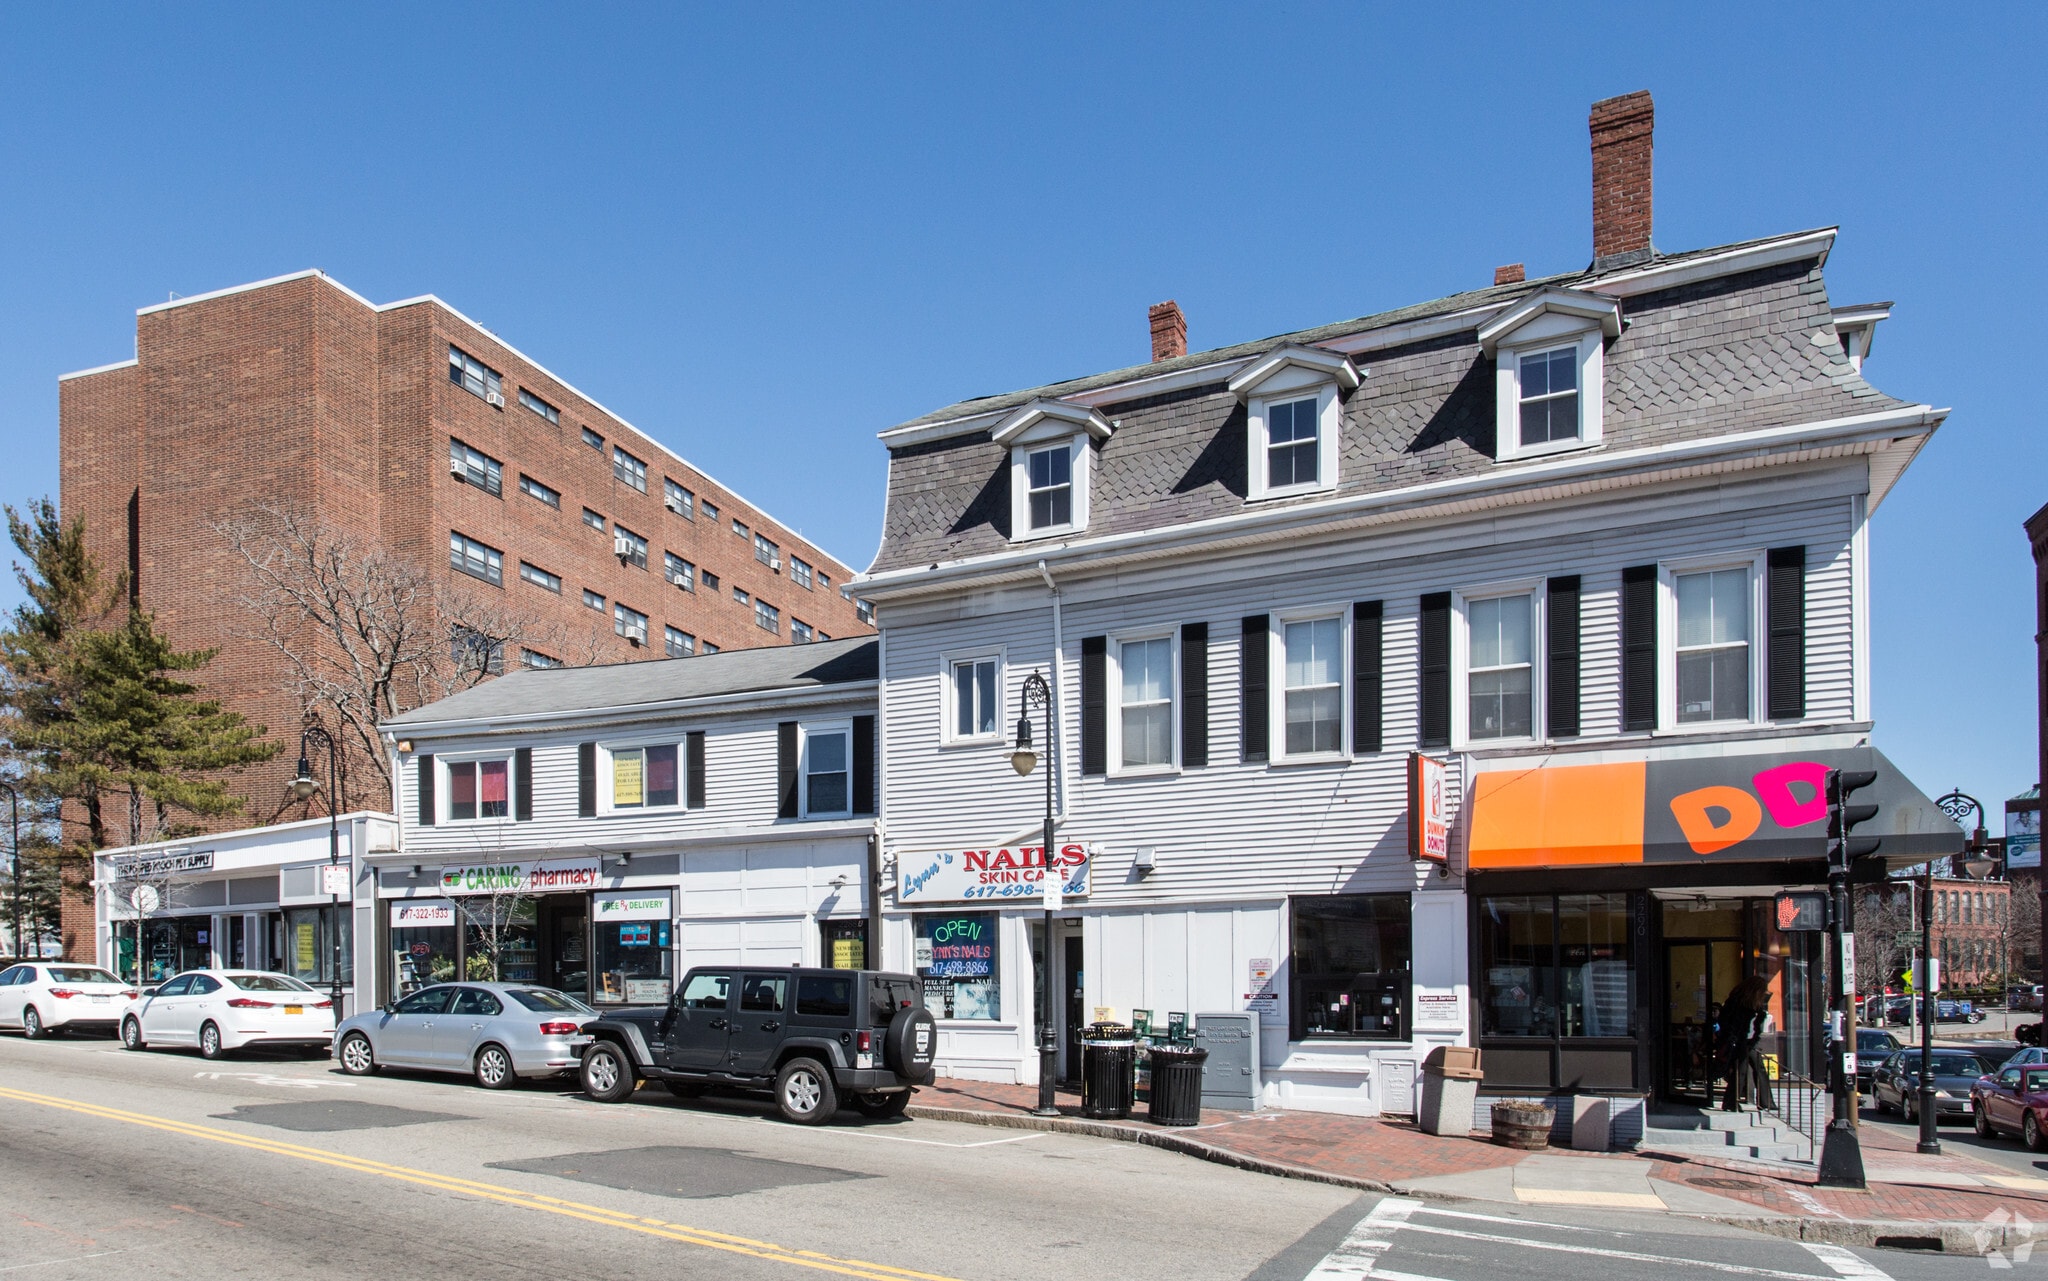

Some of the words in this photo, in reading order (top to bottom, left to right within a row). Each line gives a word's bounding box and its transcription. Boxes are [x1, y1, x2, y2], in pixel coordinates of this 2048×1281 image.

[188, 854, 210, 867] SUPPLY
[963, 844, 1087, 872] NAILS
[530, 866, 597, 889] pharmacy
[979, 870, 1021, 885] SKIN
[1023, 868, 1069, 883] CAE
[602, 901, 619, 912] FREE
[629, 900, 663, 909] DELIVERY
[399, 907, 449, 920] 617-322-1933
[935, 920, 982, 942] OPEN
[411, 944, 430, 954] OPEN
[932, 944, 960, 959] YNN'S
[961, 945, 991, 958] NAILS
[929, 961, 989, 974] 617-698-8866
